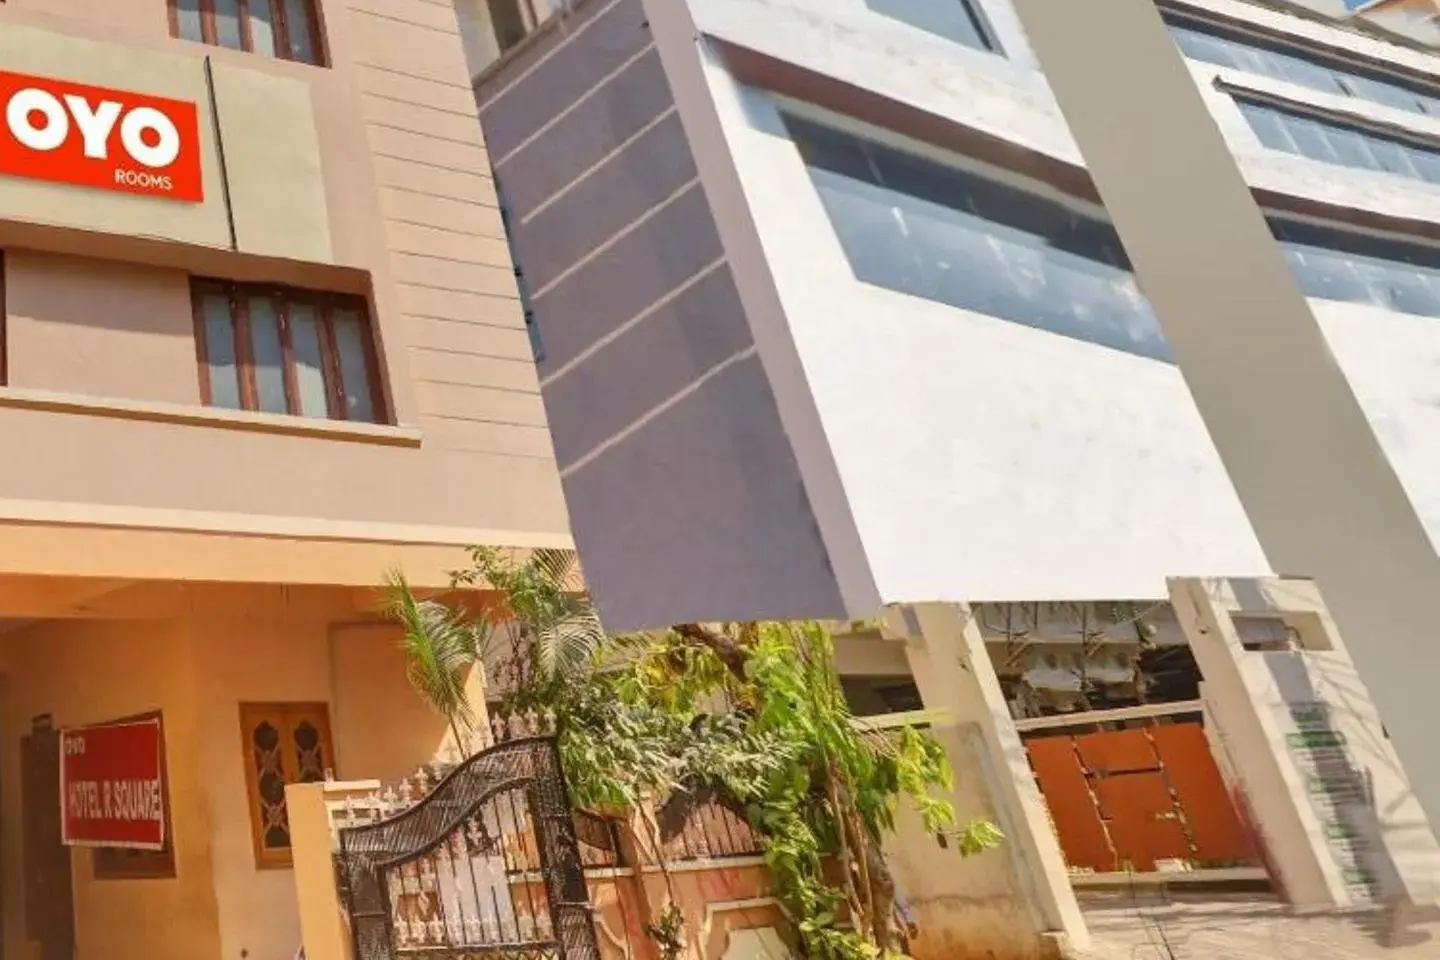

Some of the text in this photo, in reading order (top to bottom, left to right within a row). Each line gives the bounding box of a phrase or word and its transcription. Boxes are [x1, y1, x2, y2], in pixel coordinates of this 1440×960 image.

[6, 88, 180, 168] OYO
[115, 169, 173, 190] ROOMS
[114, 779, 161, 822] SQUARE
